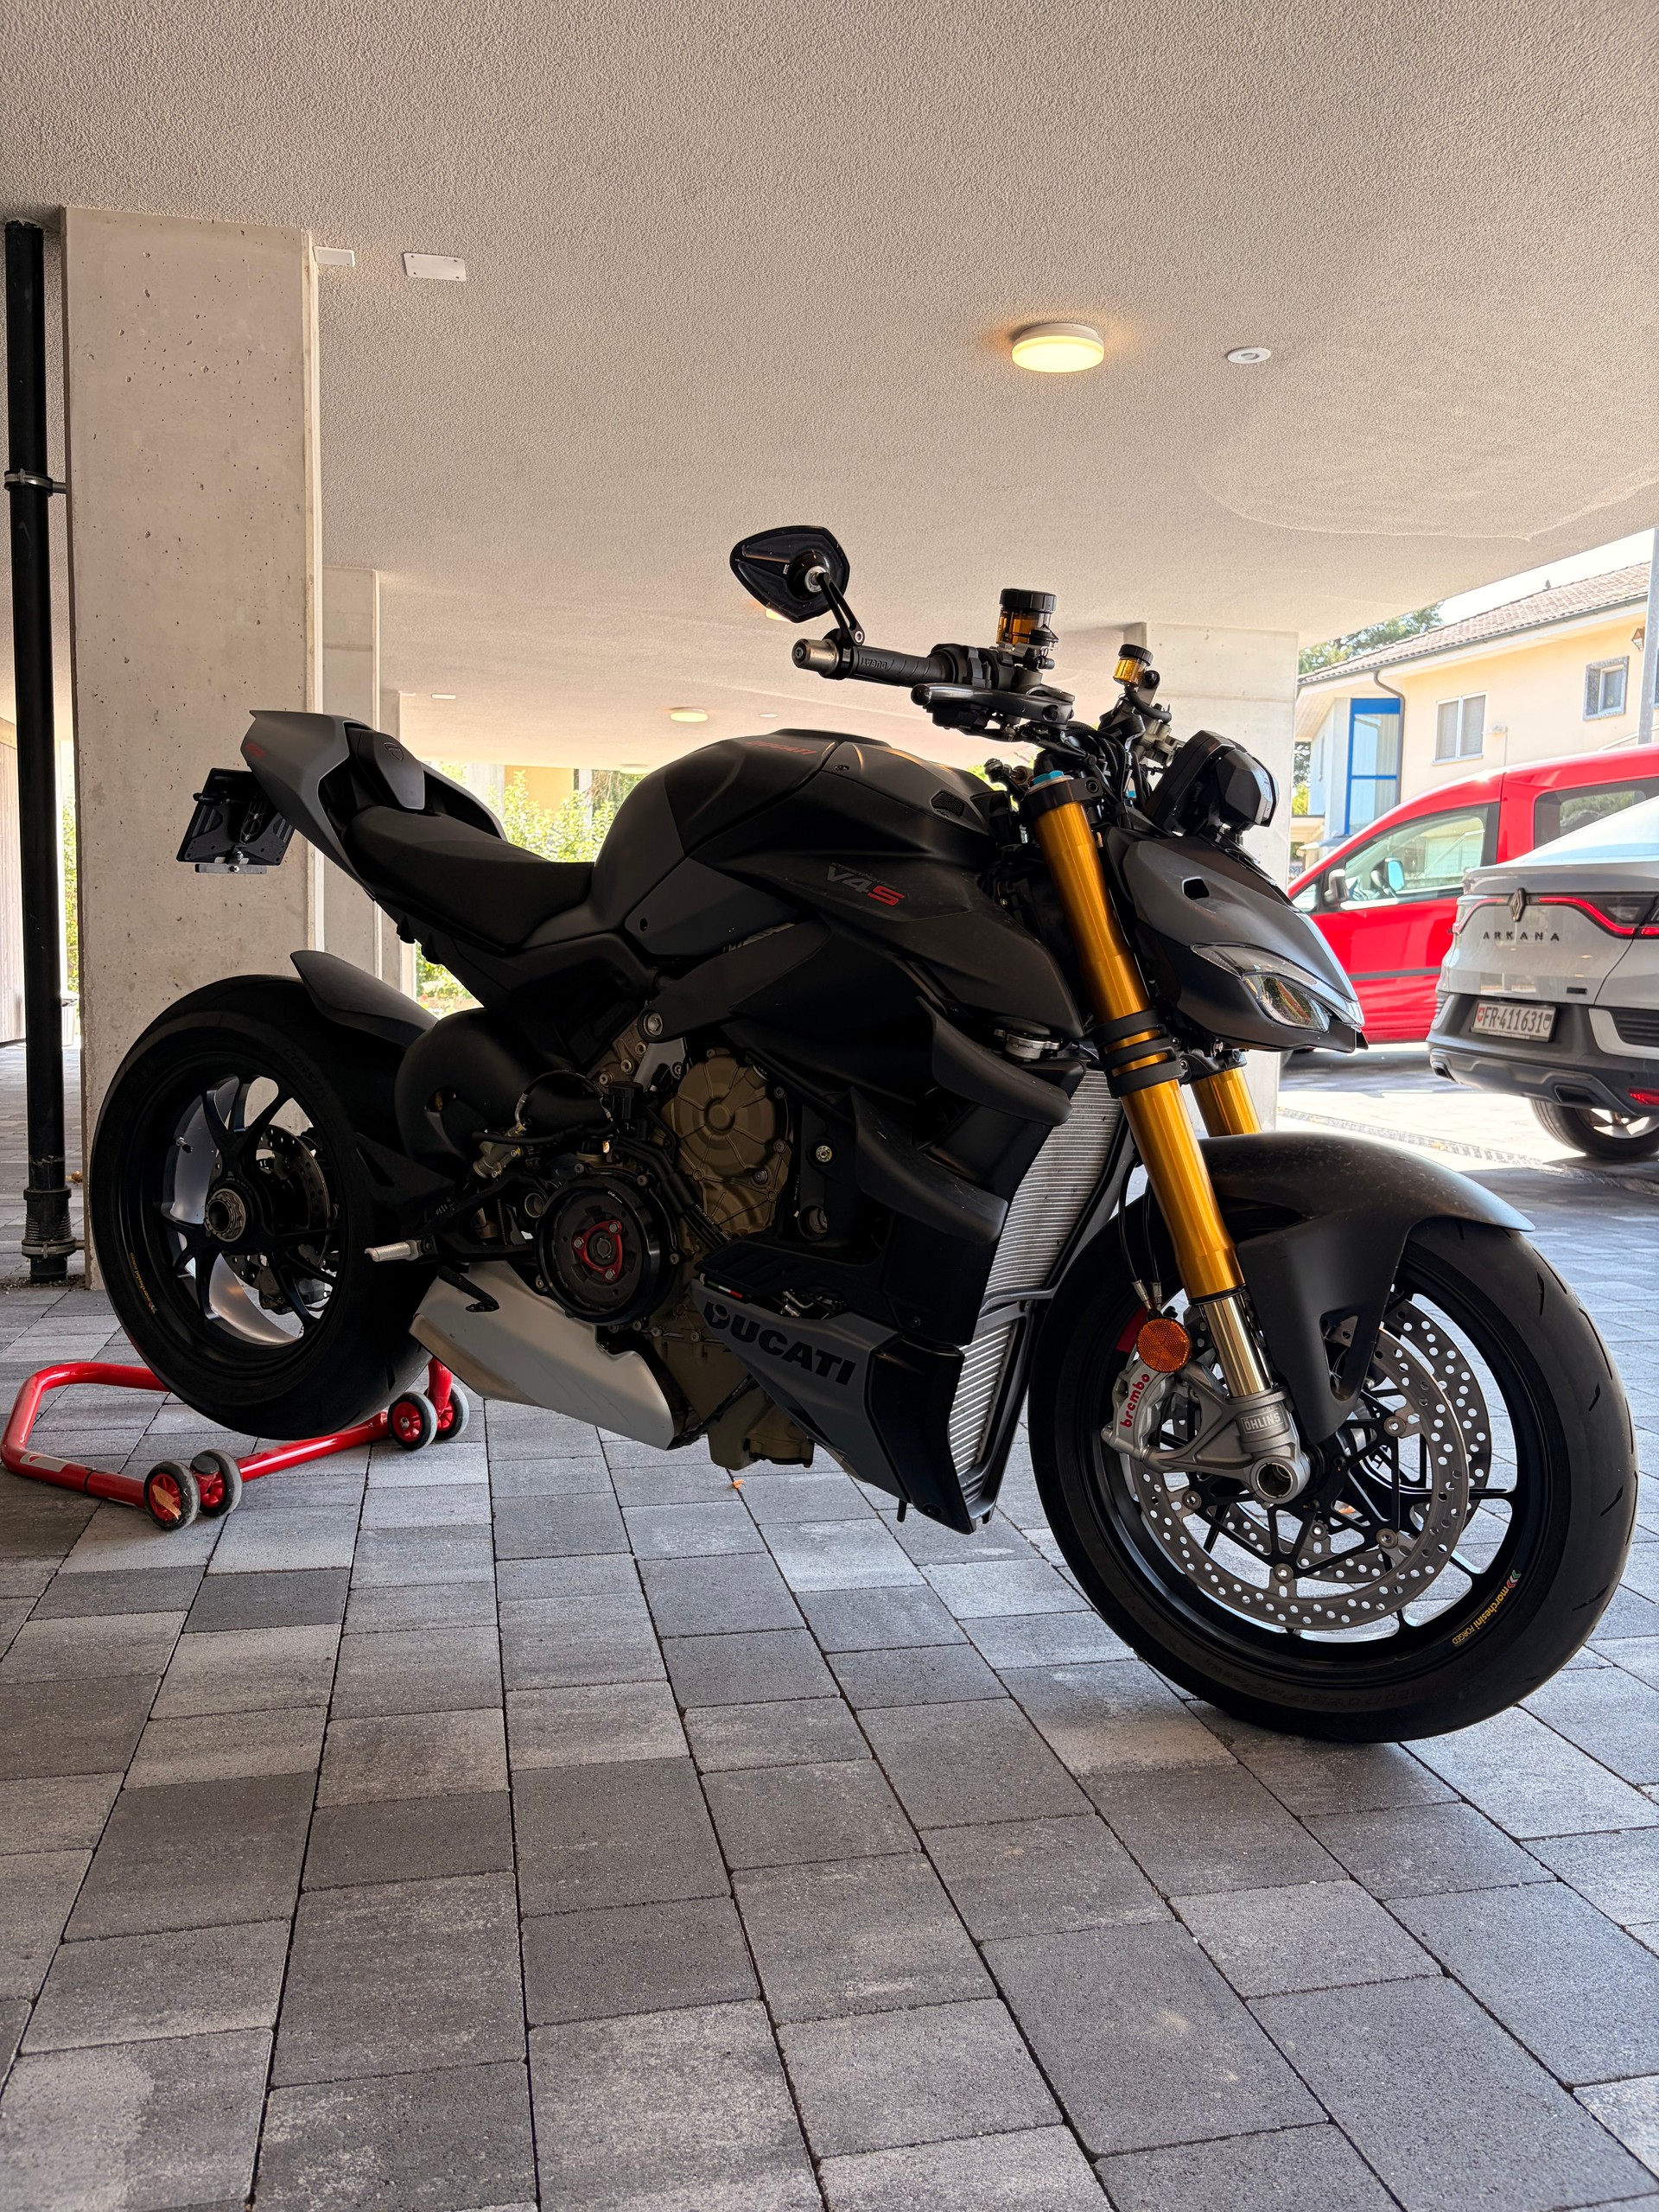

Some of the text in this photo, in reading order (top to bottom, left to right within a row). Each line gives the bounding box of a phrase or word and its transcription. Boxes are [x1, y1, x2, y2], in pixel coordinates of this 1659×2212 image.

[827, 865, 906, 906] V4S
[1483, 931, 1560, 942] ARKANA
[703, 1301, 856, 1386] DUCATI
[1120, 1374, 1150, 1427] brembo
[1243, 1412, 1281, 1431] ÖHLINS
[1452, 1586, 1510, 1645] marchesini FORGED
